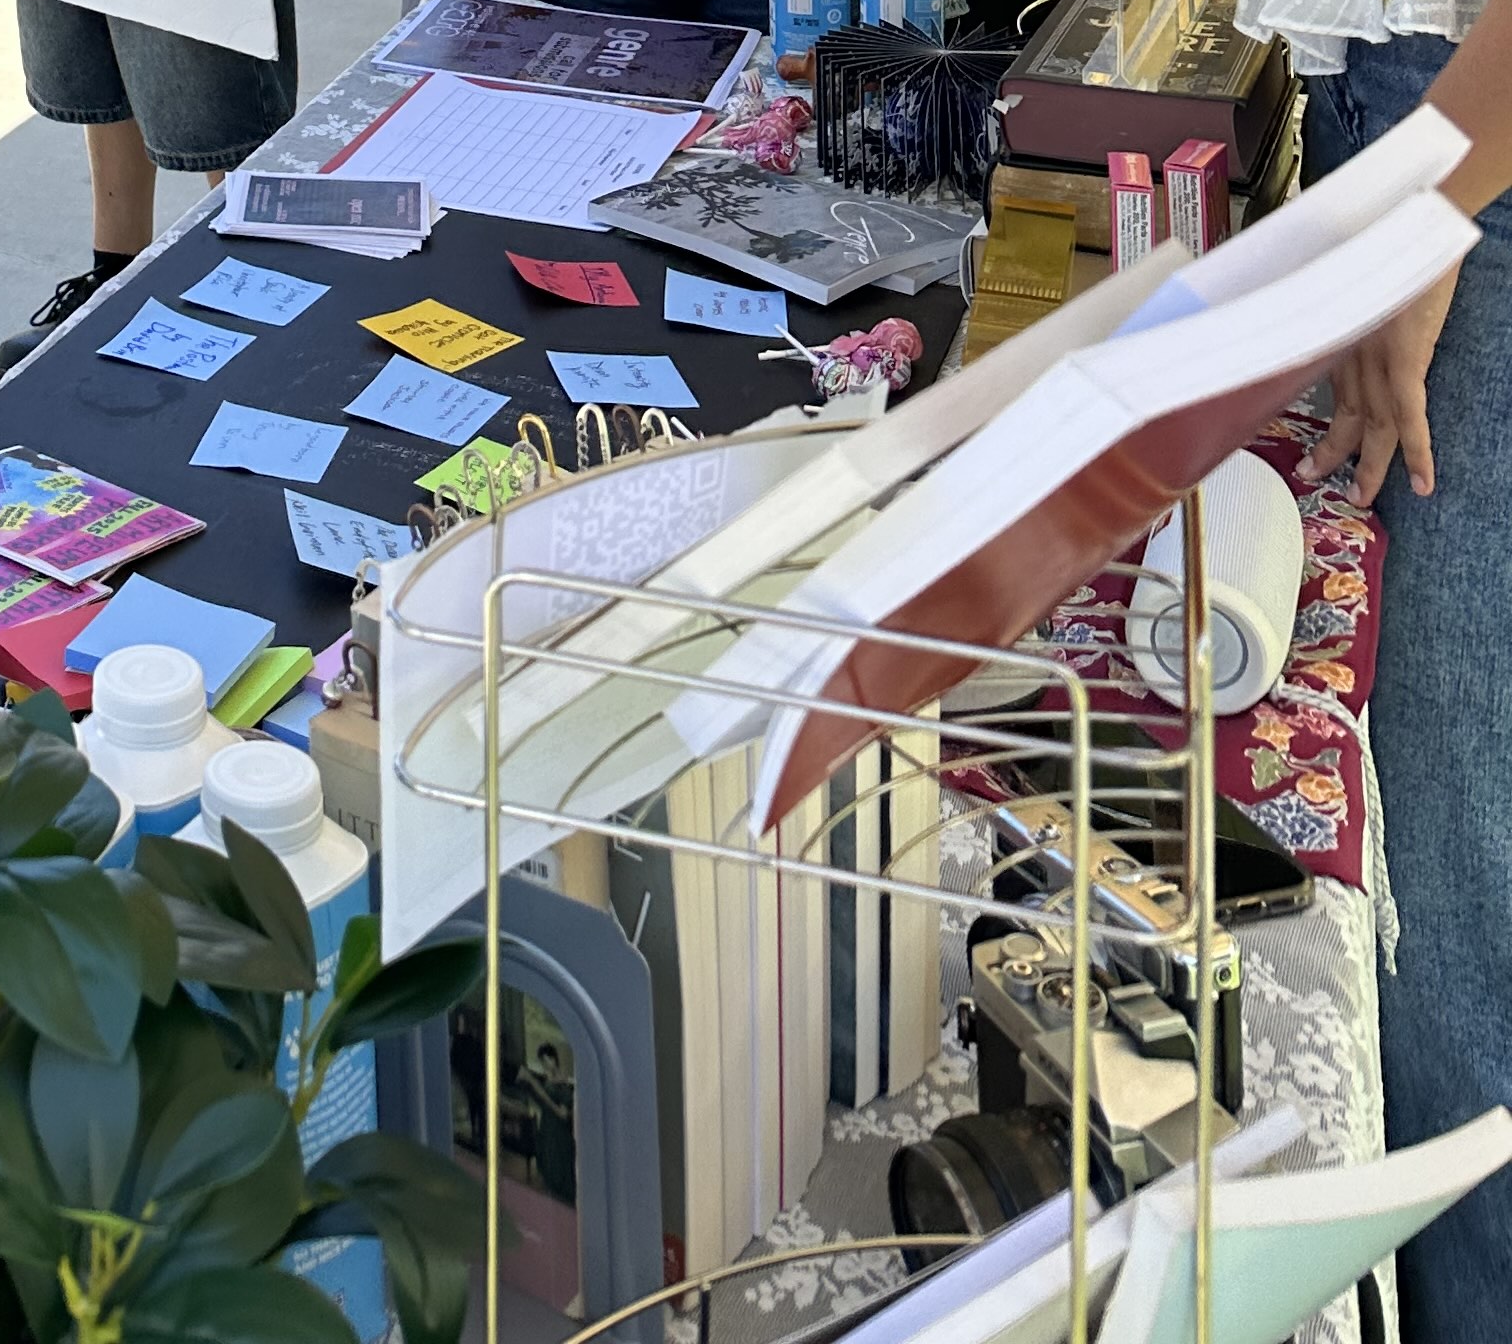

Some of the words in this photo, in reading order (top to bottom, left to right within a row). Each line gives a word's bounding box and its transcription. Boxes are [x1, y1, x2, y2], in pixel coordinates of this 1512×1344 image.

[587, 27, 648, 76] genre
[119, 499, 154, 516] FALL
[87, 512, 128, 534] 2025
